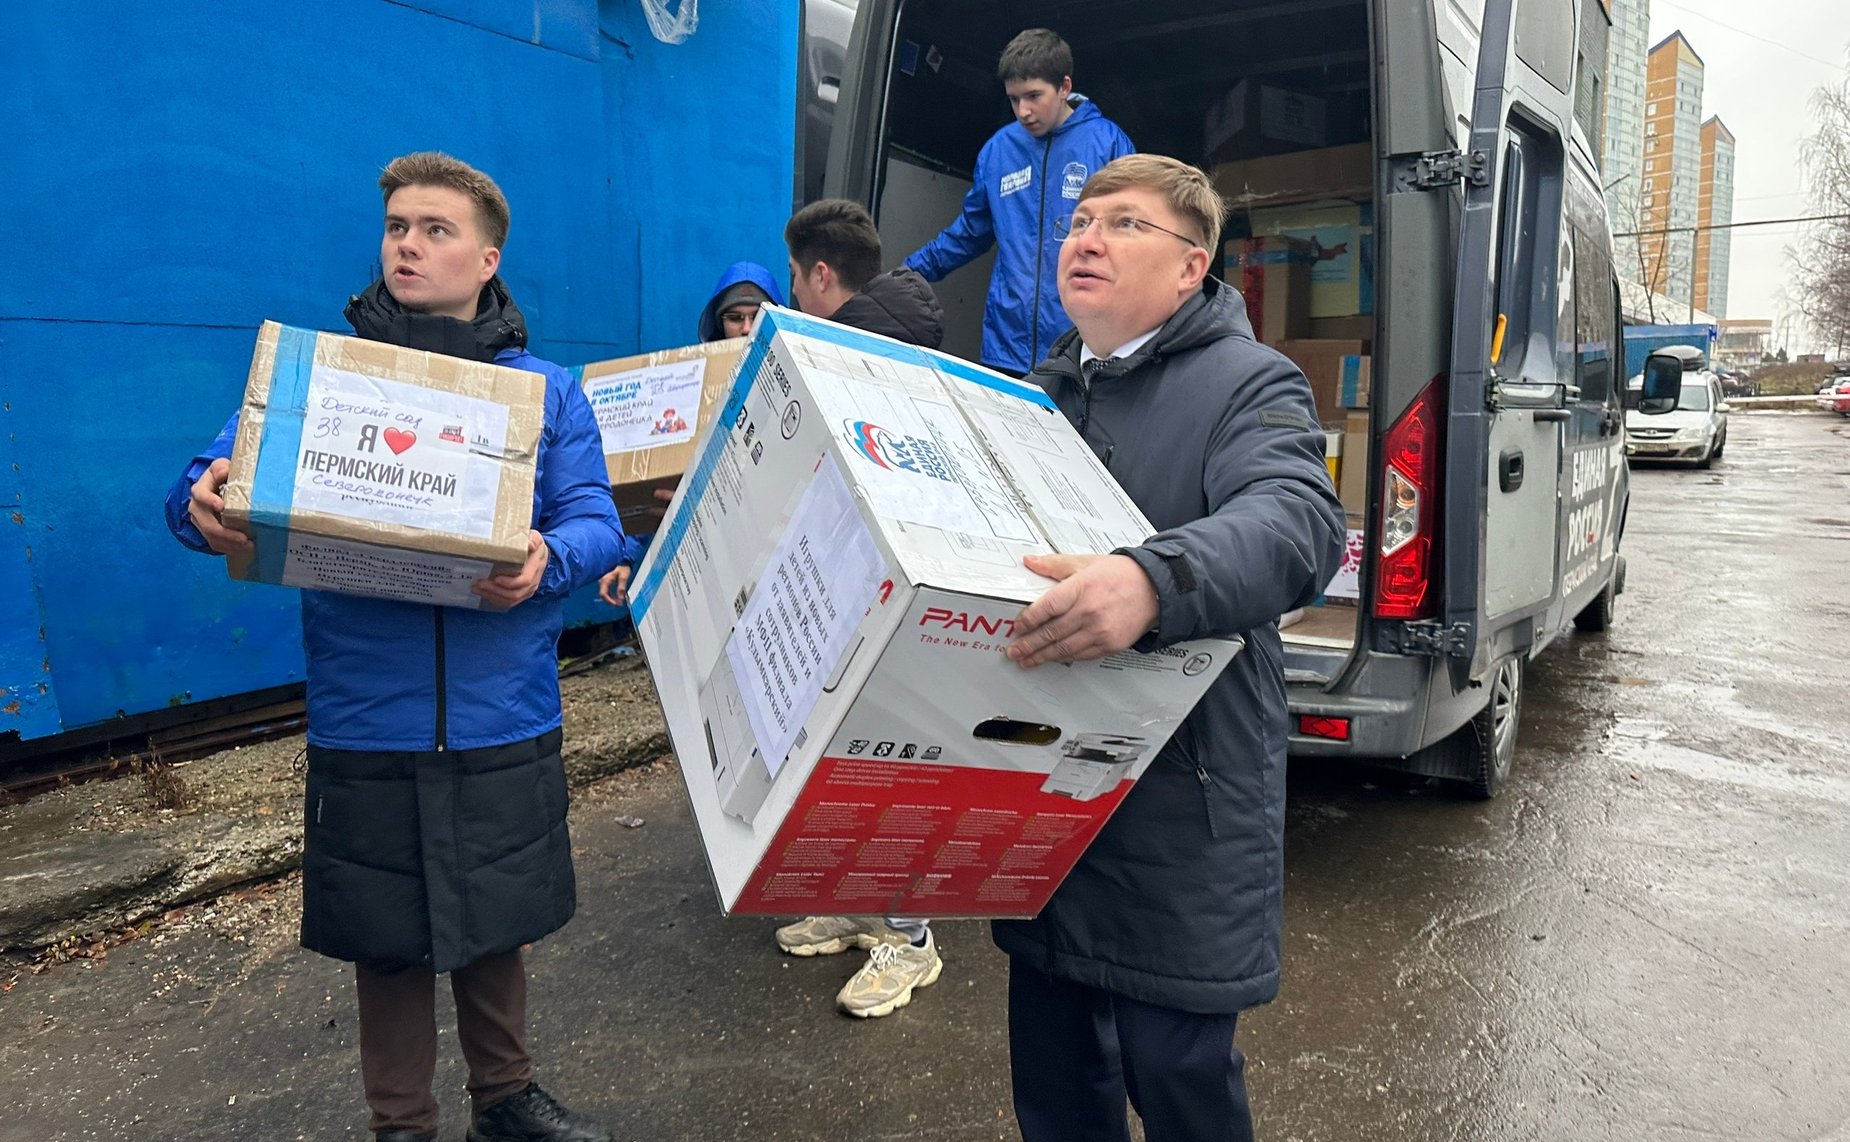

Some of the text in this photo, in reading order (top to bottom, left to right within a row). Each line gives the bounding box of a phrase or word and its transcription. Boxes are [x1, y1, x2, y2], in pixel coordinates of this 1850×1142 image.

[773, 363, 791, 398] SERIES
[313, 416, 342, 439] 38
[321, 397, 423, 430] Детский сад
[357, 423, 379, 453] Я
[302, 449, 458, 498] ПЕРМСКИЙ КРАЙ
[904, 435, 938, 478] ЕДИНАЯ
[917, 438, 952, 482] РОССИЯ
[1572, 447, 1607, 502] ЕДИНАЯ
[1567, 498, 1603, 561] РОССИЯ
[787, 550, 830, 645] детей из новых
[799, 534, 838, 622] Игрушки для
[770, 581, 812, 681] от заявителей и
[776, 562, 822, 667] регионов России
[919, 607, 1015, 638] PANT
[754, 613, 794, 711] МФЦ филиала
[764, 607, 799, 687] сотрудников
[919, 633, 1006, 653] The New Era fo
